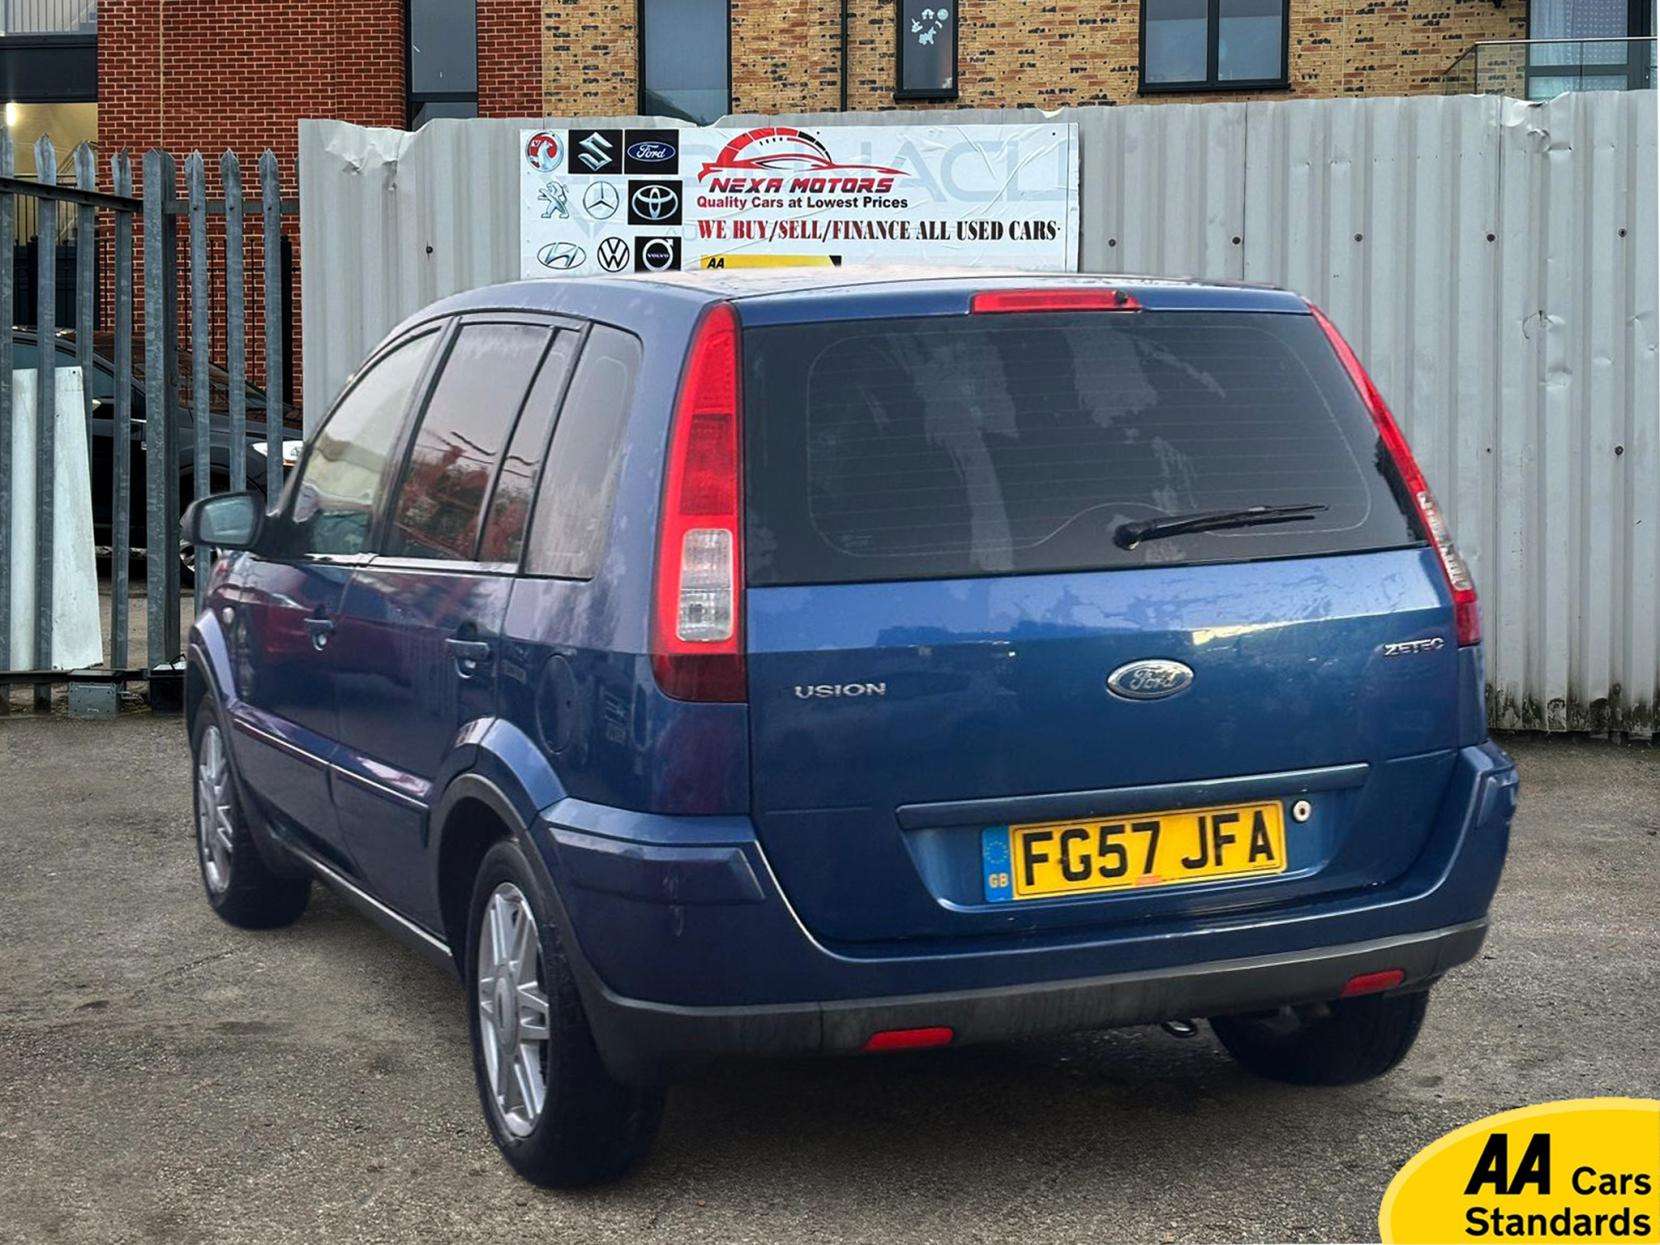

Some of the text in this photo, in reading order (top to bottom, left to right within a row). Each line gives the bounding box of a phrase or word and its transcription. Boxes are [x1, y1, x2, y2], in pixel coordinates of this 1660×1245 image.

[636, 144, 666, 158] Ford
[709, 177, 894, 193] NEXA MOTORS
[697, 196, 908, 211] Quality Cars at Lowest Prices
[697, 220, 727, 240] WE
[916, 220, 950, 240] ALL
[957, 220, 1003, 241] USED
[1008, 220, 1057, 241] CARS
[706, 258, 725, 269] AA
[1385, 638, 1444, 656] ZETEC
[1129, 665, 1178, 691] Ford
[1022, 810, 1275, 886] FG57 JFA
[989, 873, 1008, 888] GB
